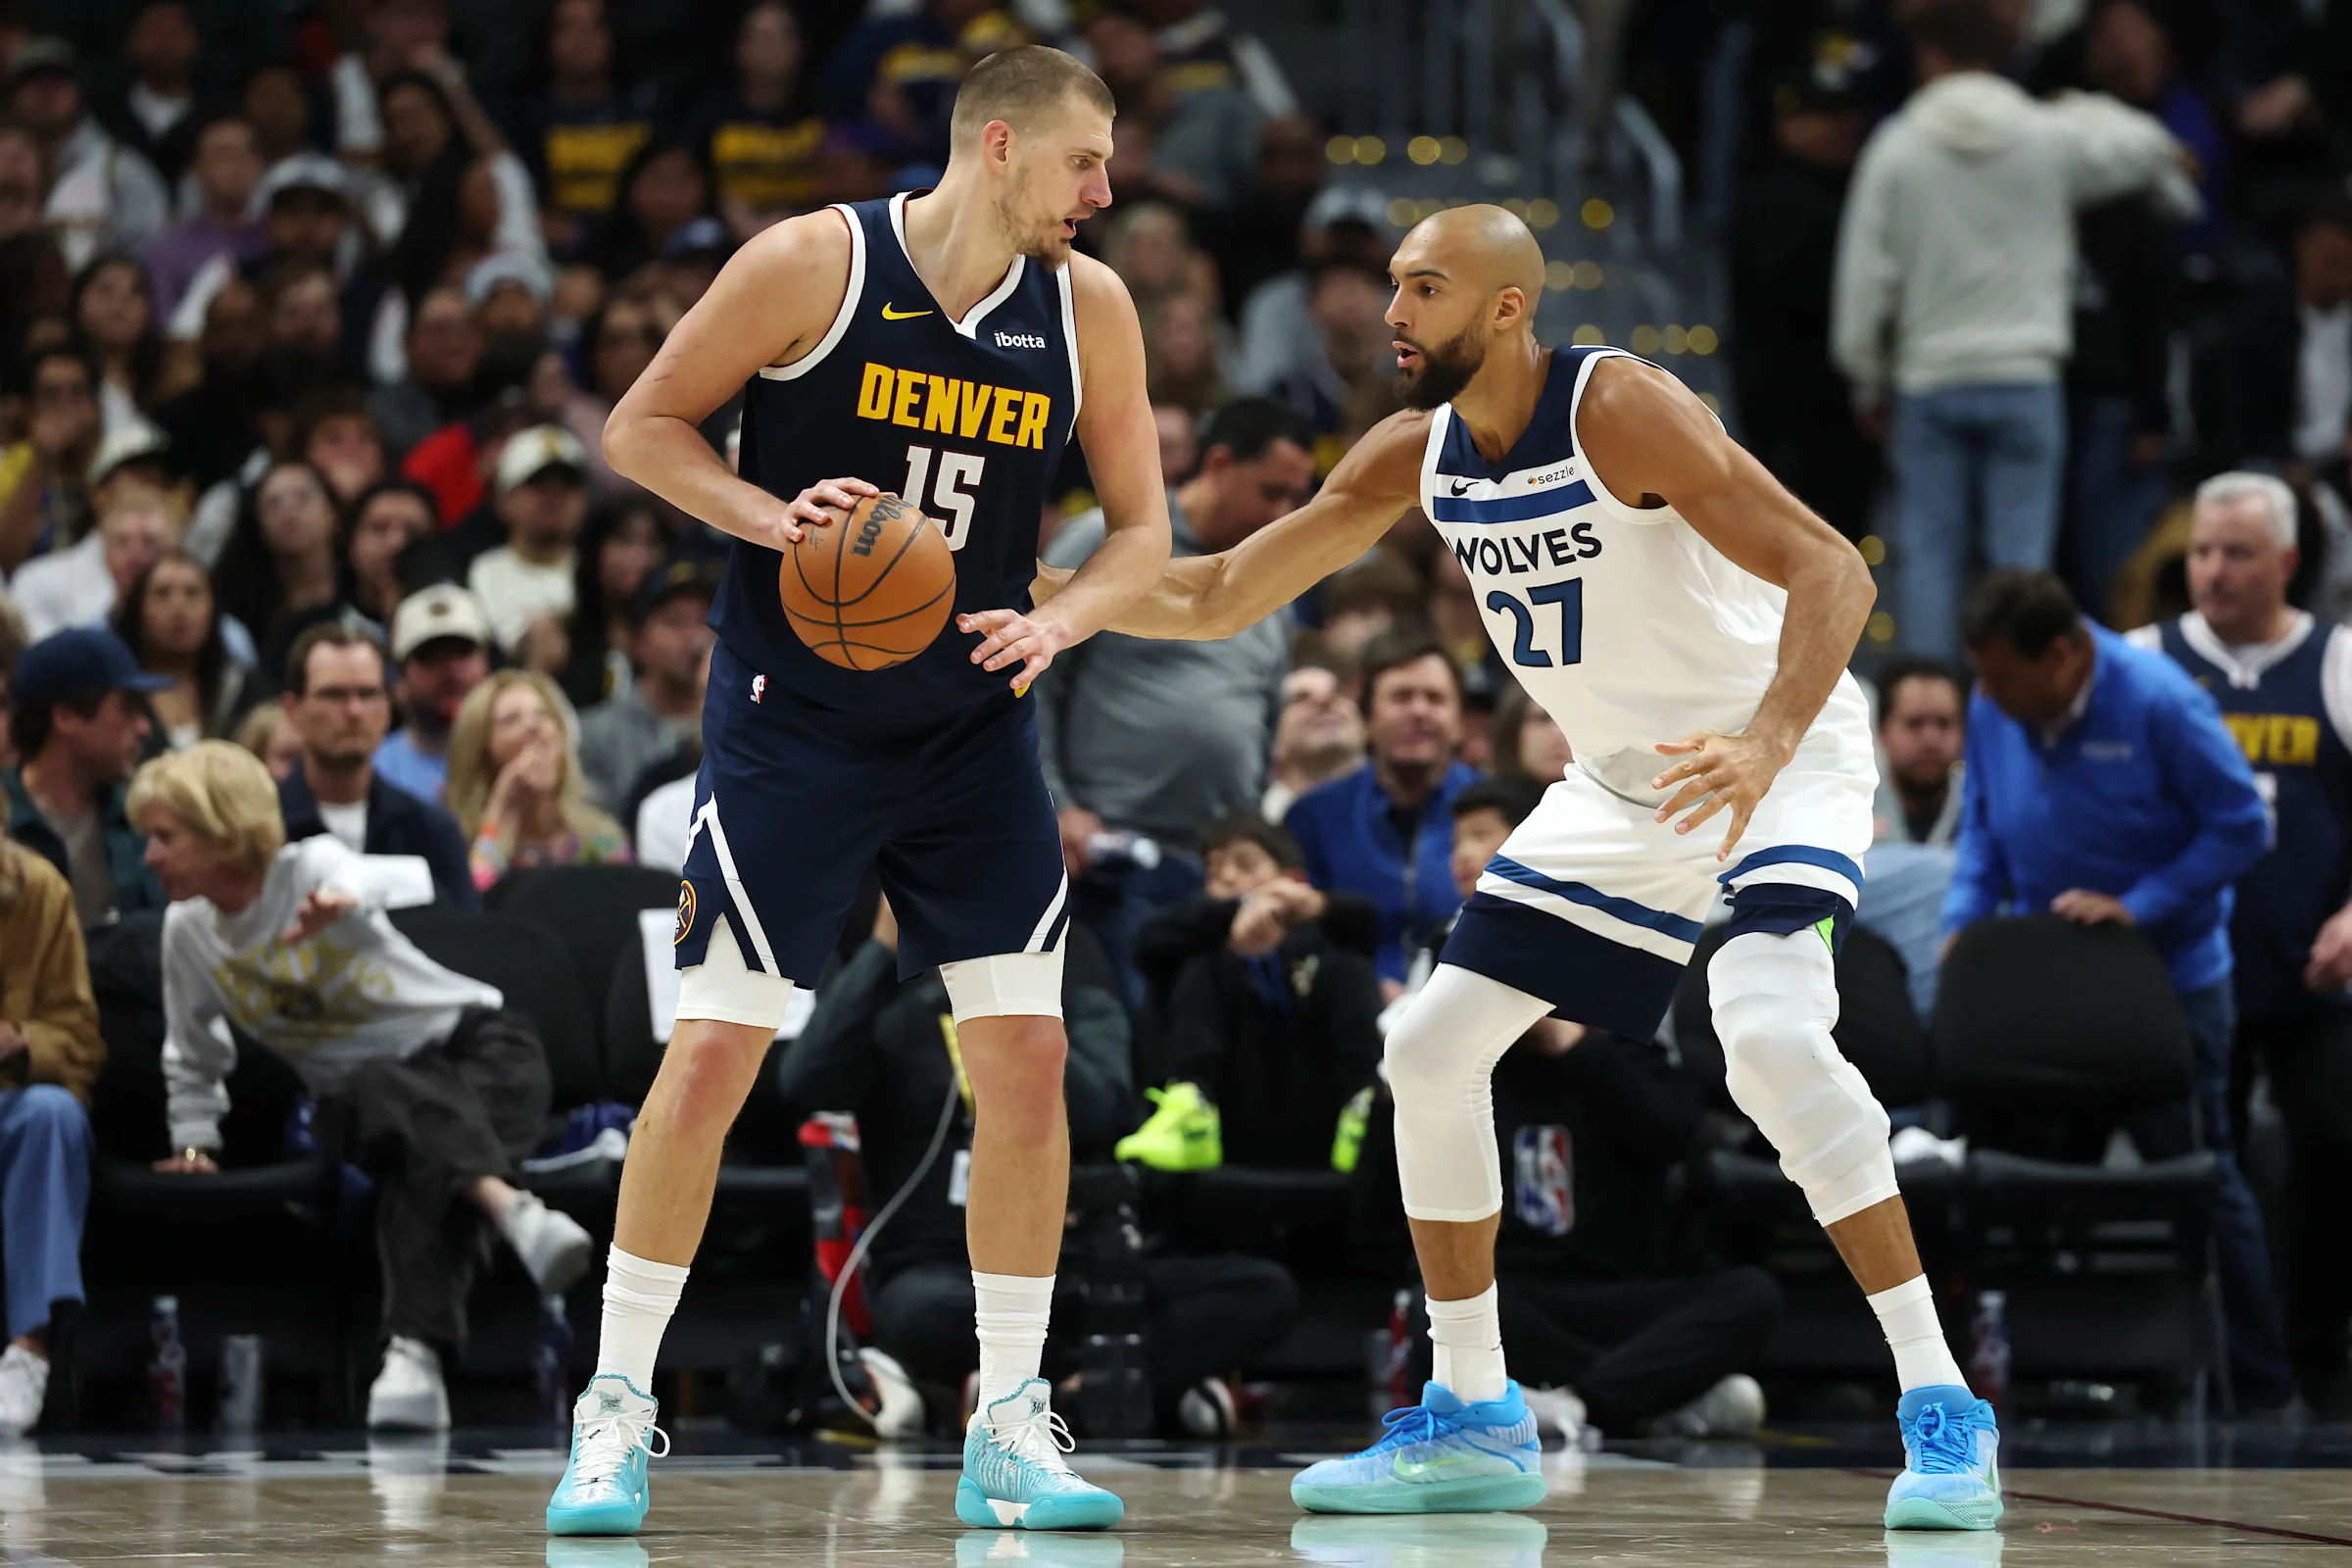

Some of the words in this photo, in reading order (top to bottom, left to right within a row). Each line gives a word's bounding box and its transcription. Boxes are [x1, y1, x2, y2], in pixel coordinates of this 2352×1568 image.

[994, 331, 1046, 348] ibotta
[857, 362, 1051, 450] DENVER
[903, 444, 986, 552] 15
[1538, 466, 1575, 484] sezzle
[1486, 576, 1583, 667] 27
